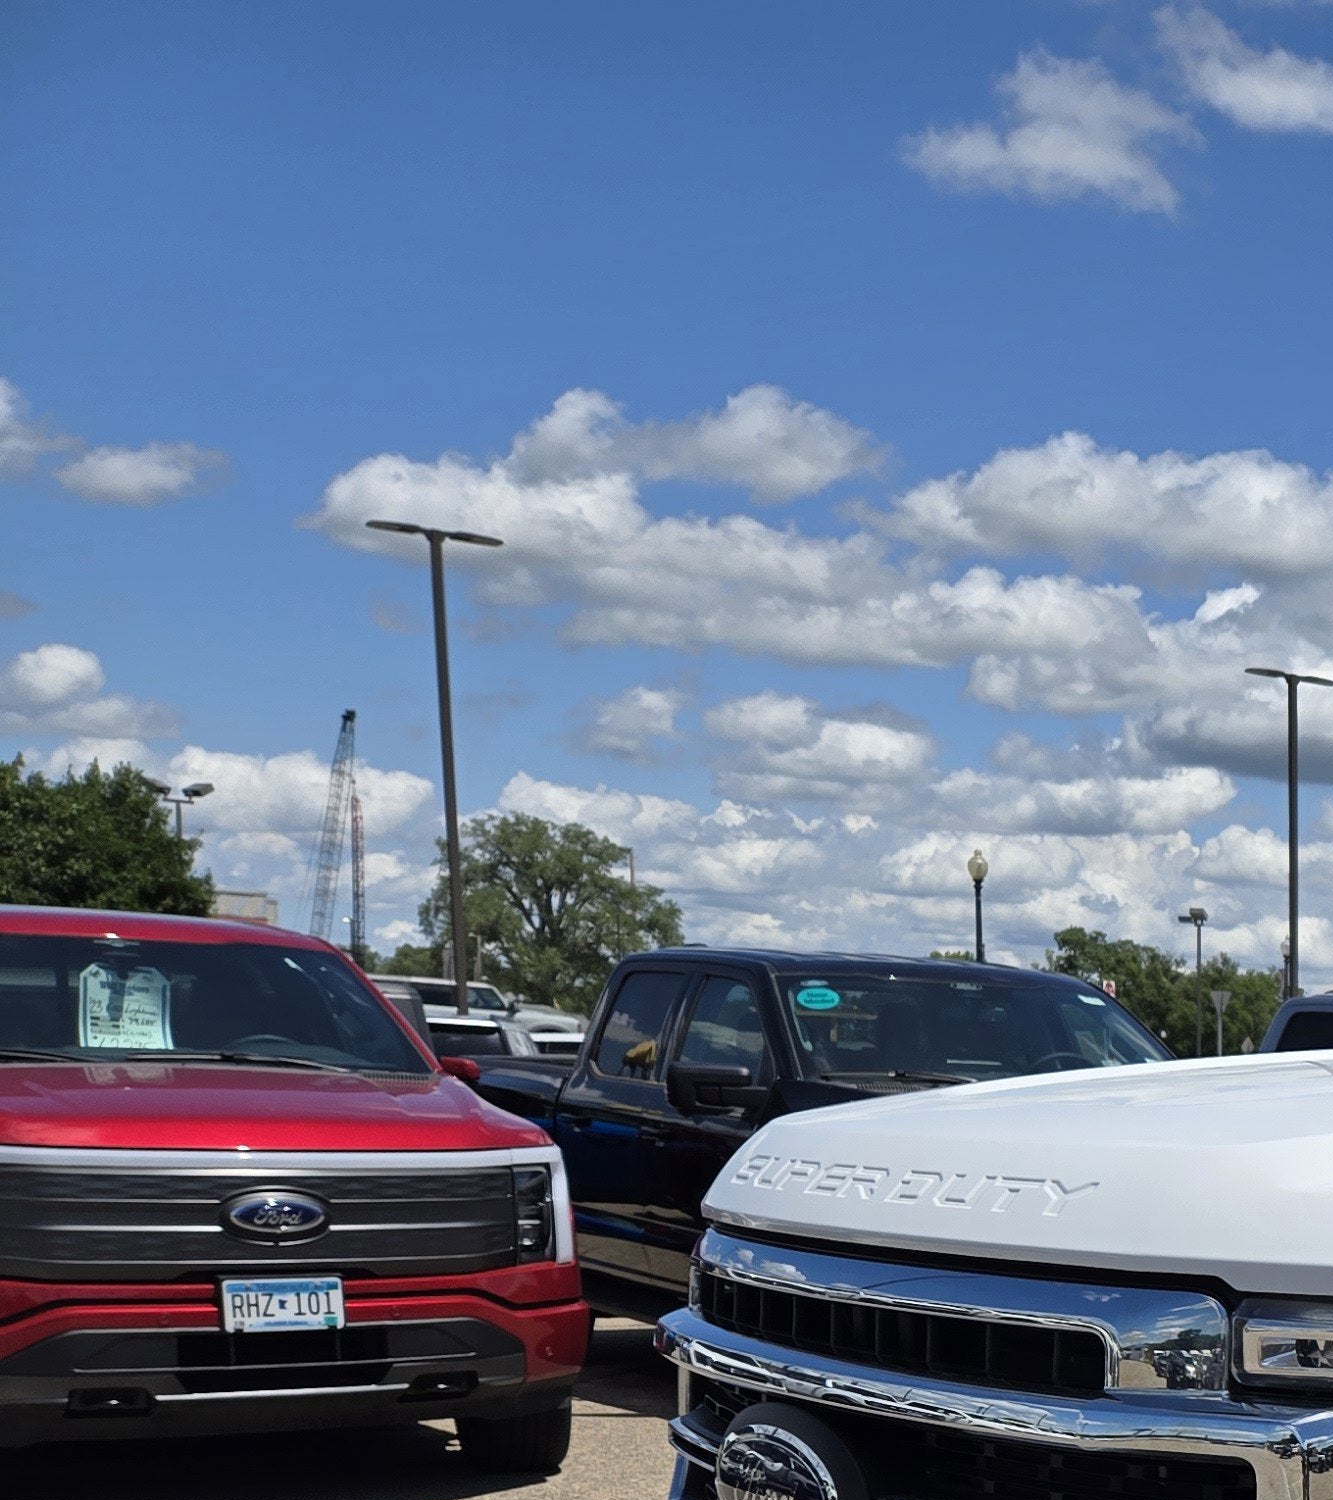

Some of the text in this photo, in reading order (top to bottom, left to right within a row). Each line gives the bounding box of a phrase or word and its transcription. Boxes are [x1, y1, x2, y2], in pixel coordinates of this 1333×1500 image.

[731, 1154, 1100, 1216] SUPER DUTY
[253, 1208, 303, 1226] Ford
[231, 1291, 336, 1319] RHZ 101
